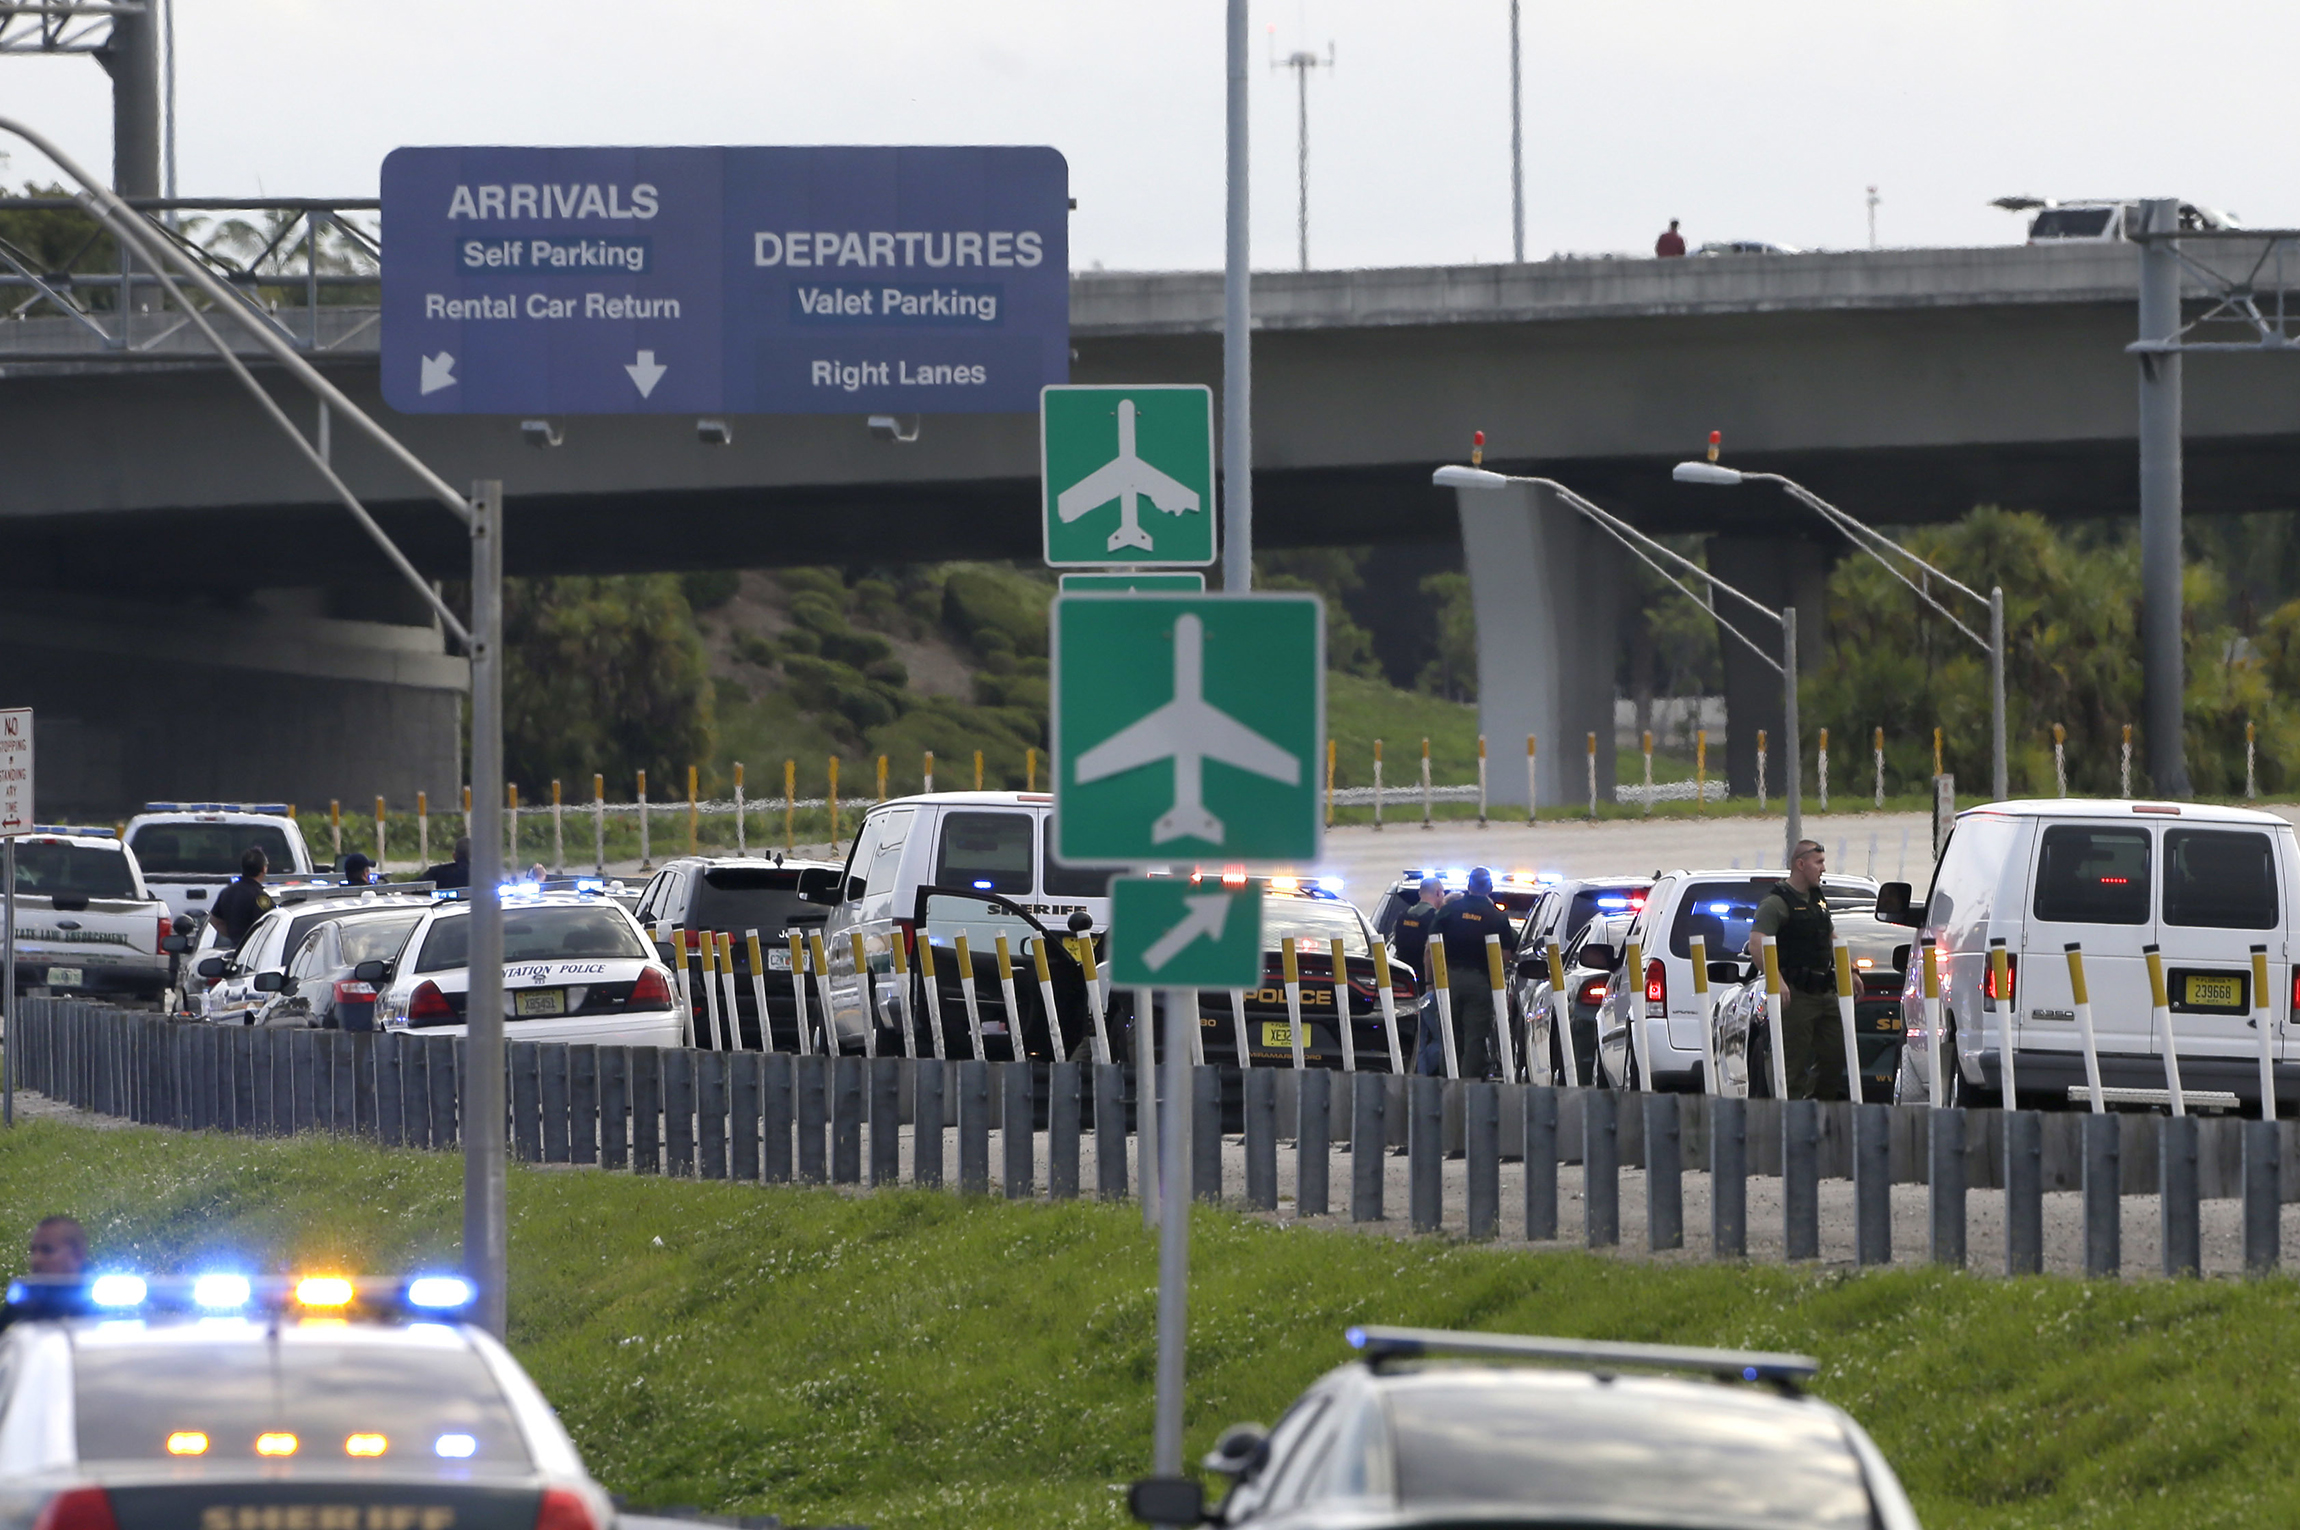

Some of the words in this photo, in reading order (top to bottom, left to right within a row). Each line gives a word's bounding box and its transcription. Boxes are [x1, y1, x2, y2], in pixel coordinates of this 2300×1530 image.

[447, 183, 659, 220] ARRIVALS
[463, 240, 523, 267] Self
[531, 240, 644, 271] Parking
[754, 231, 1044, 267] DEPARTURES
[425, 294, 517, 319] Rental
[526, 294, 577, 319] Car
[585, 293, 681, 319] Return
[798, 287, 873, 315] Valet
[881, 288, 997, 321] Parking
[811, 361, 890, 391] Right
[899, 361, 987, 385] Lanes
[4, 716, 18, 736] NO
[559, 964, 606, 975] POLICE
[1242, 988, 1333, 1006] POLCE
[2195, 984, 2231, 999] 239668
